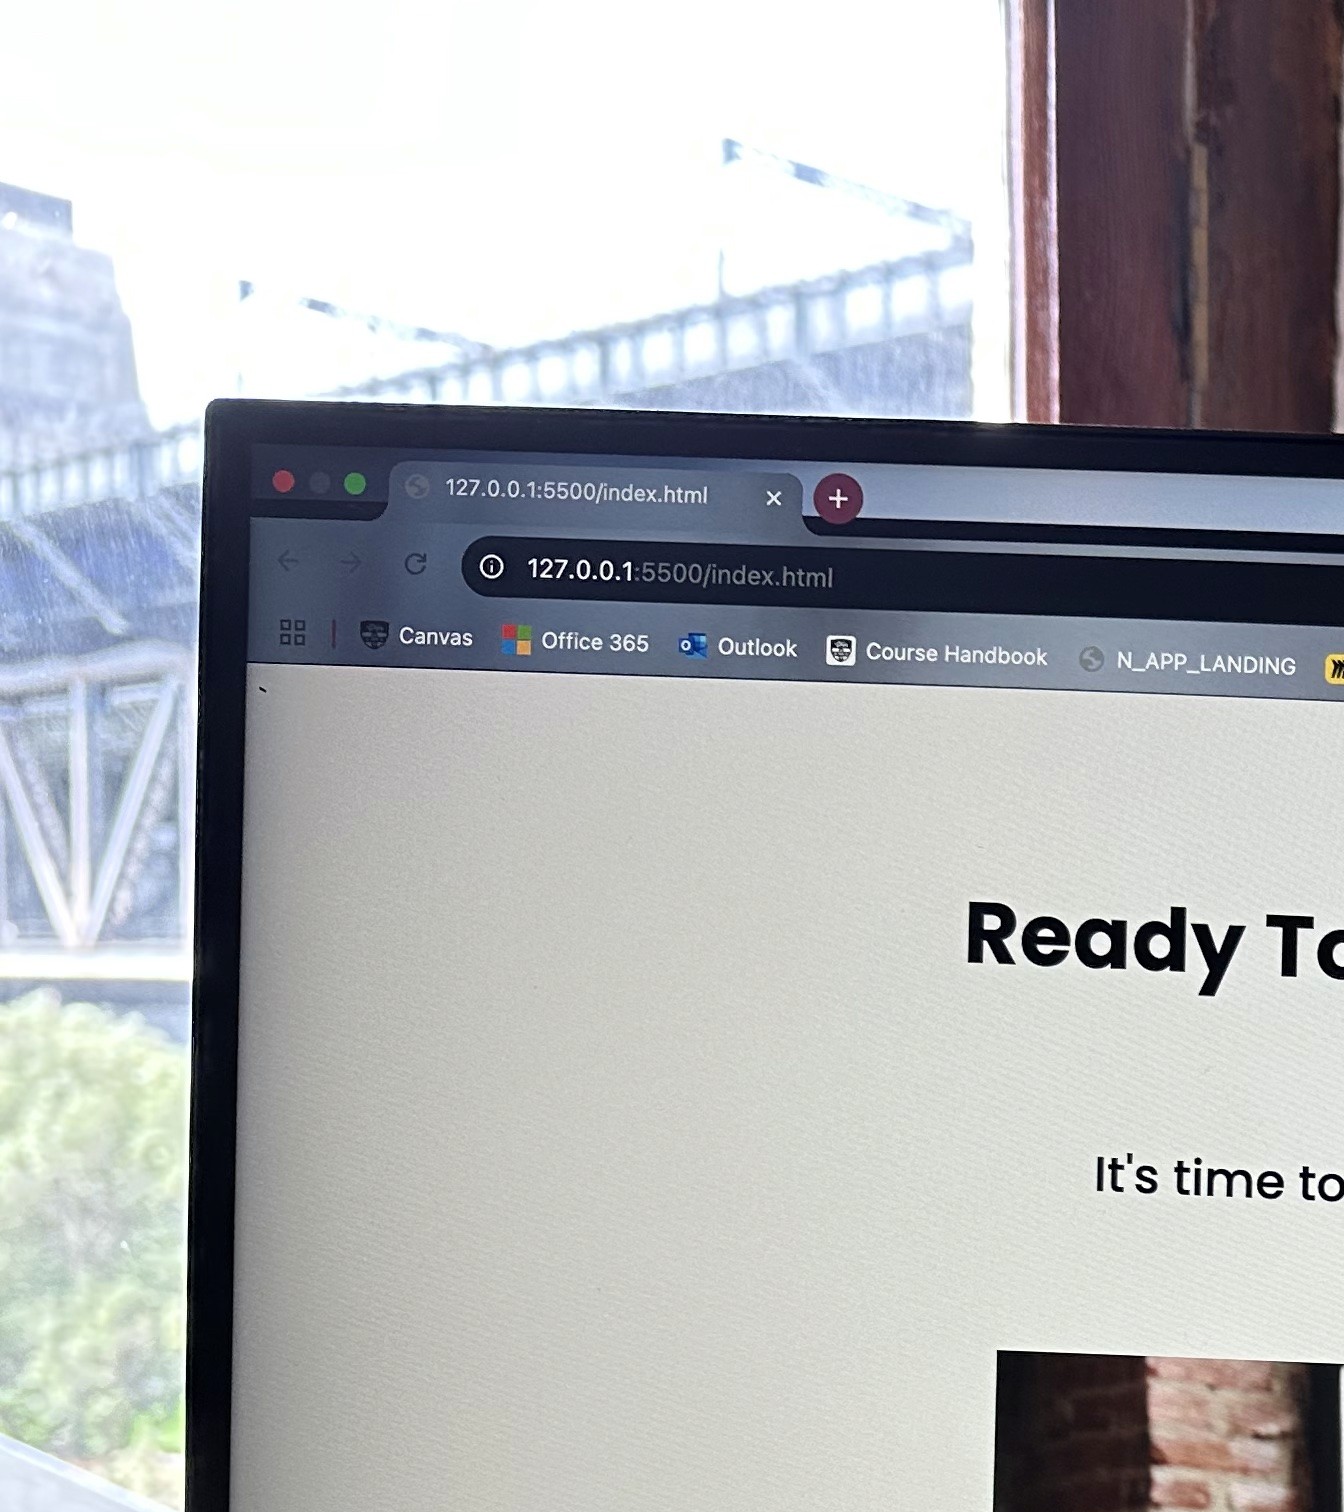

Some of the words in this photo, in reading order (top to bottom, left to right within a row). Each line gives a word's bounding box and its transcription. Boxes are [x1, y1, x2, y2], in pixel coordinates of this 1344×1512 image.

[446, 478, 708, 505] 127.0.0.1:5500/index.html
[527, 557, 833, 589] 127.0.0.1:5500/index.html
[399, 626, 473, 646] Canvas
[541, 631, 604, 652] Office
[608, 633, 650, 653] 365
[718, 637, 798, 658] Outlook
[866, 641, 939, 662] Course
[944, 645, 1048, 666] Handbook
[1117, 651, 1296, 676] N_APP_LANDING
[967, 901, 1247, 997] Ready
[1096, 1152, 1159, 1194] It's
[1173, 1156, 1285, 1200] time
